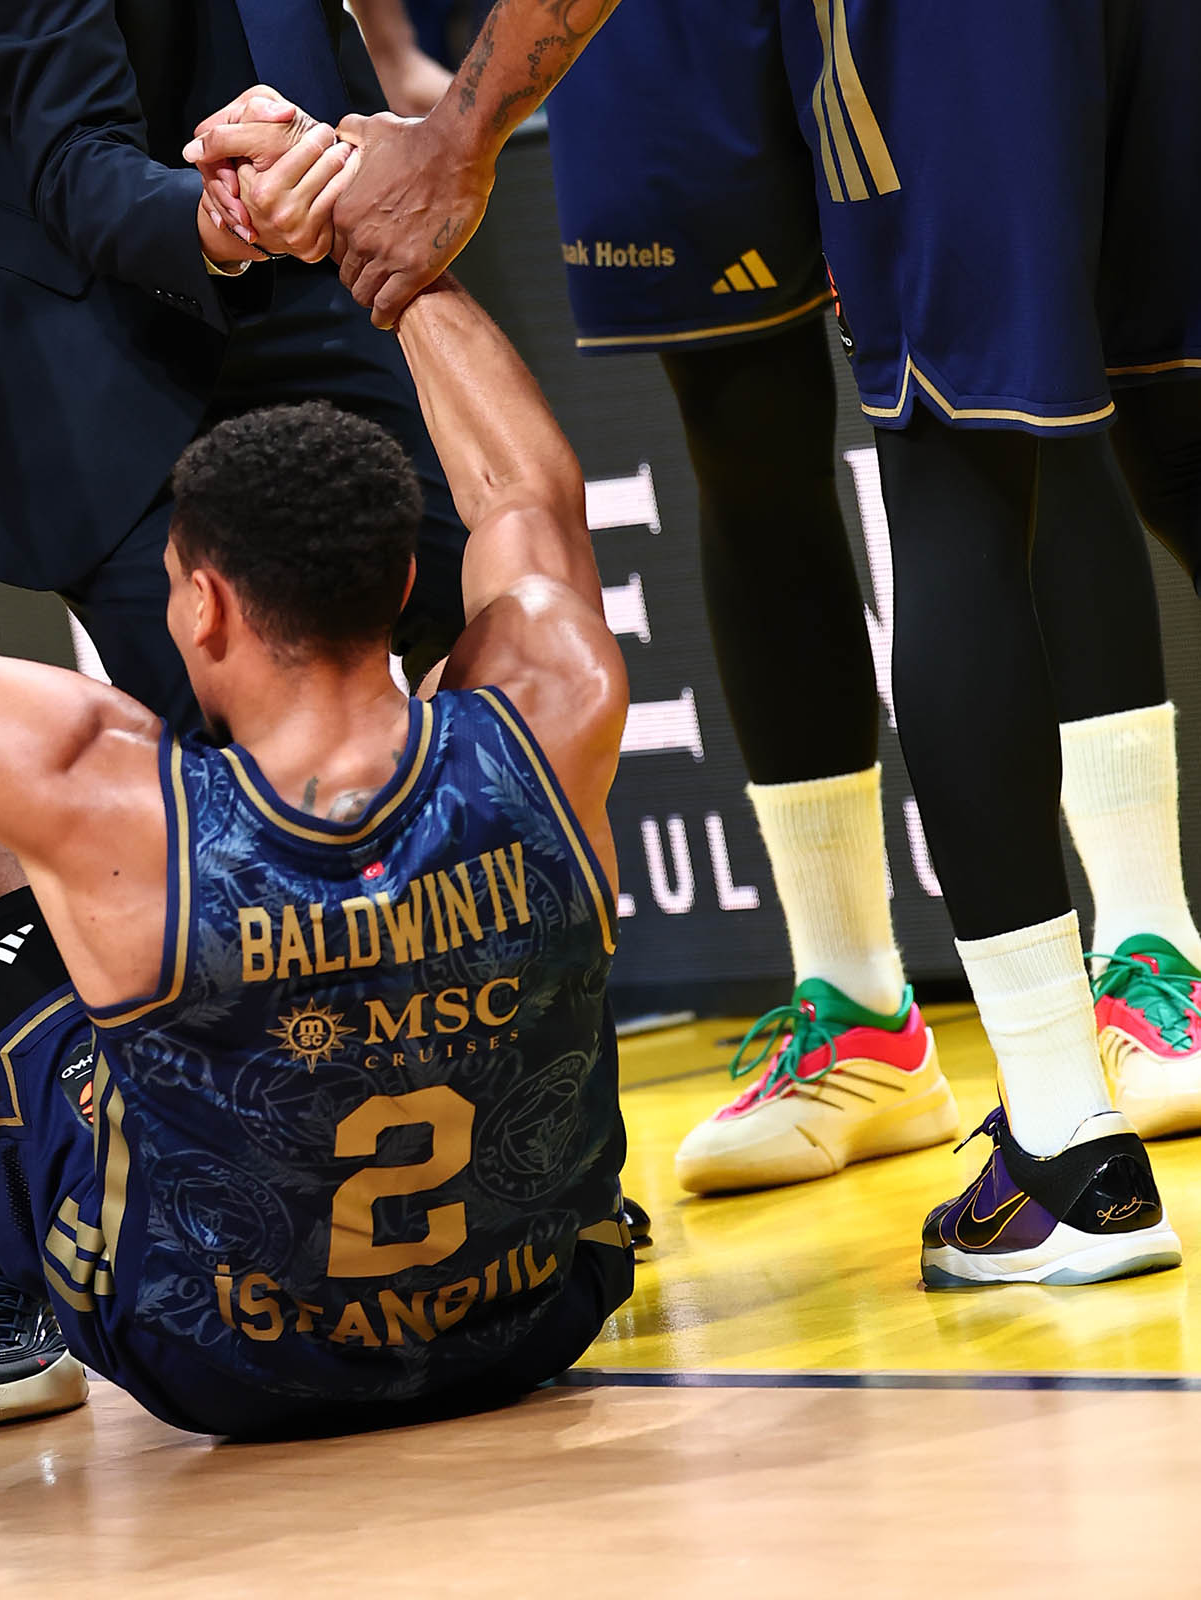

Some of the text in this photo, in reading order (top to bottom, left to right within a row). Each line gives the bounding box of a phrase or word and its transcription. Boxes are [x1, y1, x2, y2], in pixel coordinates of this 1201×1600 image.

[595, 242, 676, 267] Hotels
[238, 841, 531, 982] BALDWIN IV
[364, 977, 520, 1045] MSC
[365, 1029, 519, 1069] CRUISES
[327, 1086, 476, 1278] 2
